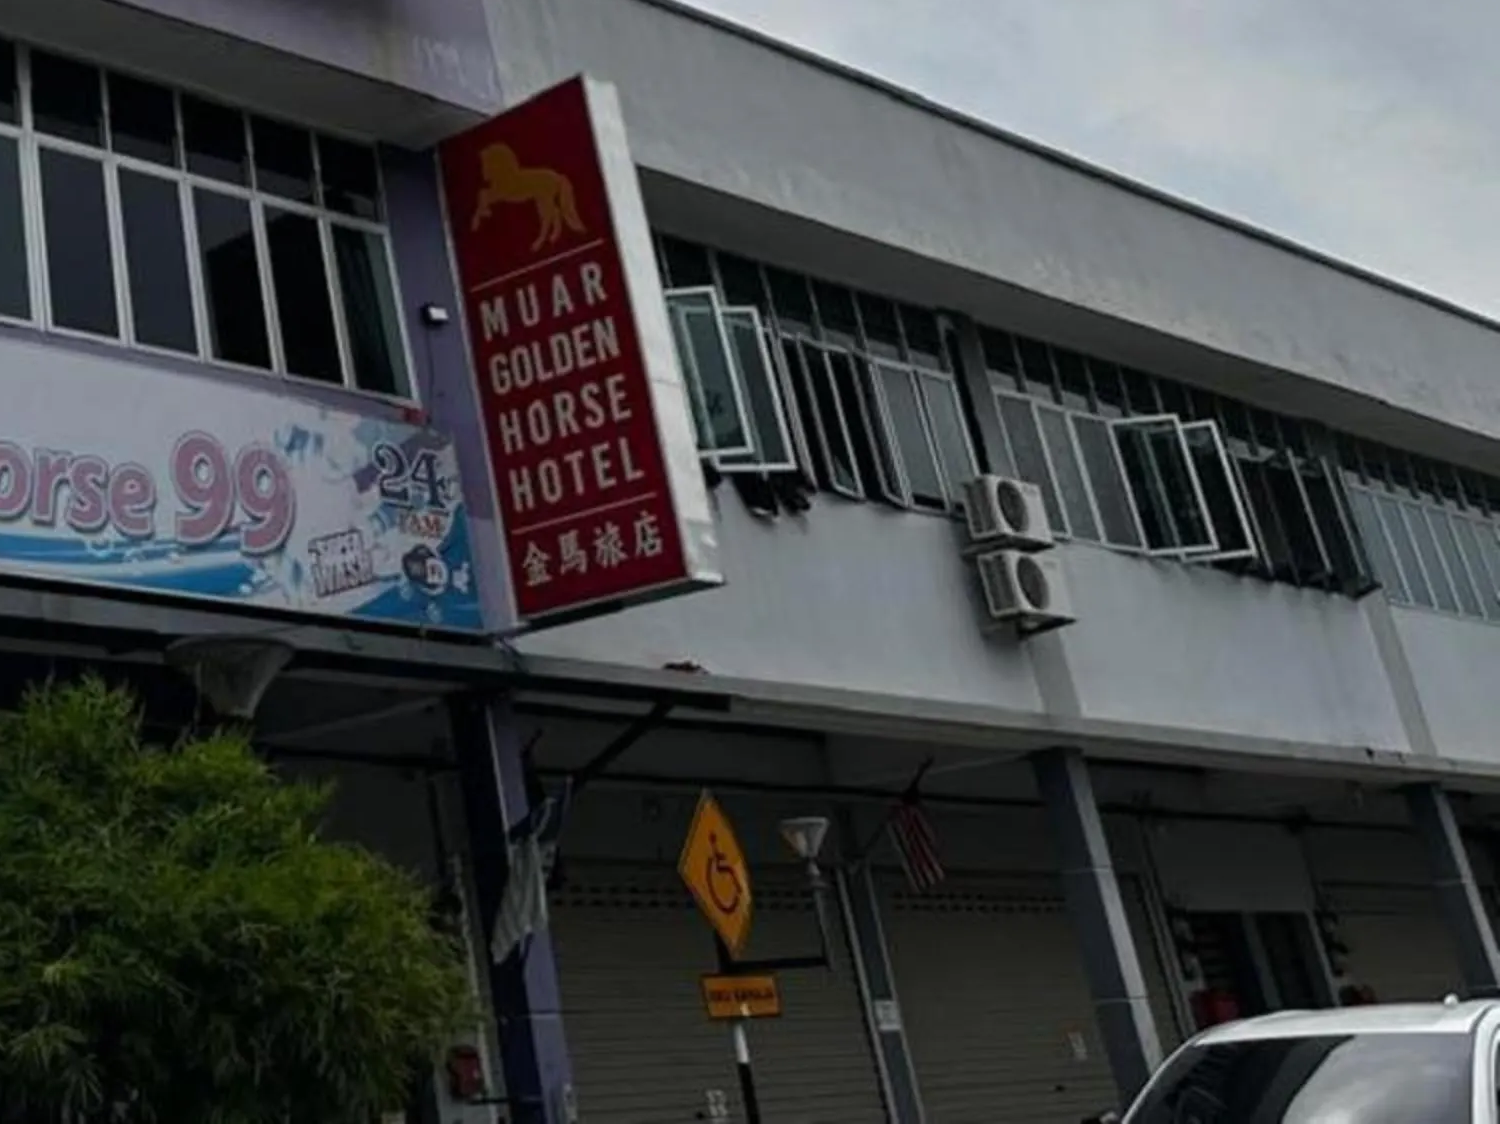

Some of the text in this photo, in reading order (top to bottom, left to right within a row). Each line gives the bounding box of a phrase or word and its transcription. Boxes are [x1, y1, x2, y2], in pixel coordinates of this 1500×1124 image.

[478, 260, 607, 342] MUAR
[488, 316, 620, 395] GOLDEN
[499, 372, 633, 456] HORSE
[171, 428, 296, 555] 99
[509, 436, 645, 513] HOTEL
[521, 512, 665, 587] 金馬旅店
